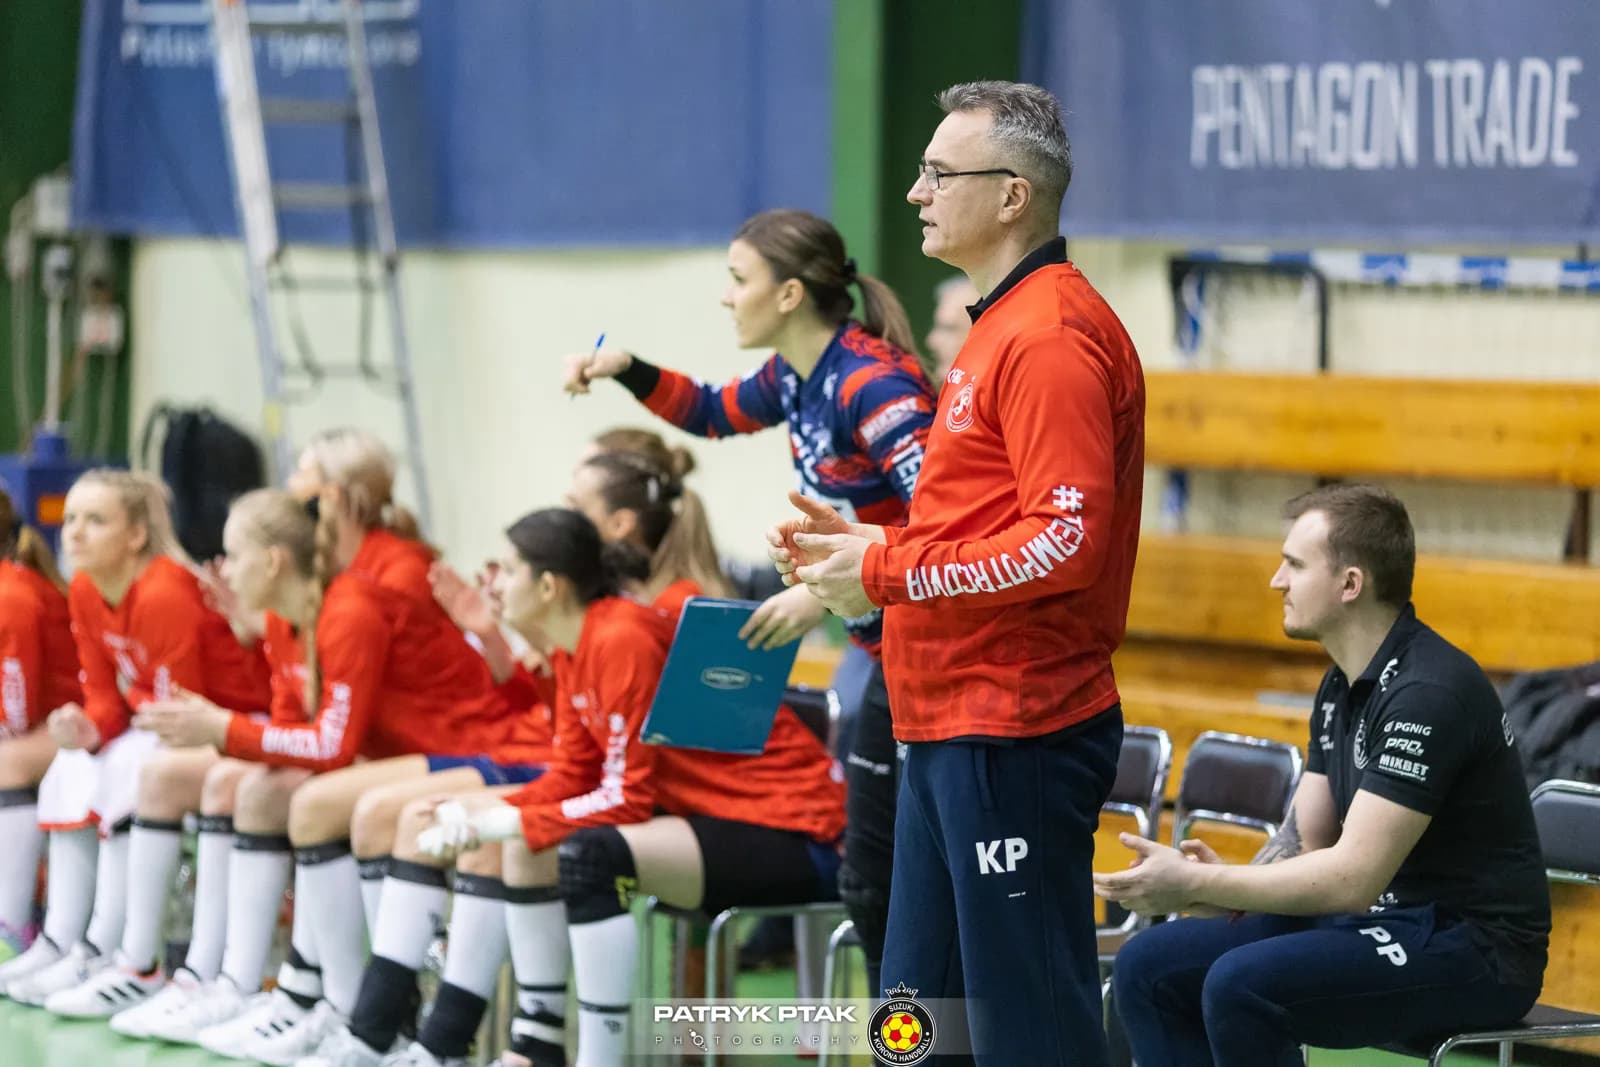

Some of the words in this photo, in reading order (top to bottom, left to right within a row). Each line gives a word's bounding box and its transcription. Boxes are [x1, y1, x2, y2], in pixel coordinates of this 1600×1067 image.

[1191, 61, 1418, 168] PENTAGON
[1425, 56, 1583, 168] TRADE
[1379, 753, 1429, 777] MIXBET
[976, 837, 1028, 875] KP
[1358, 926, 1408, 967] PP
